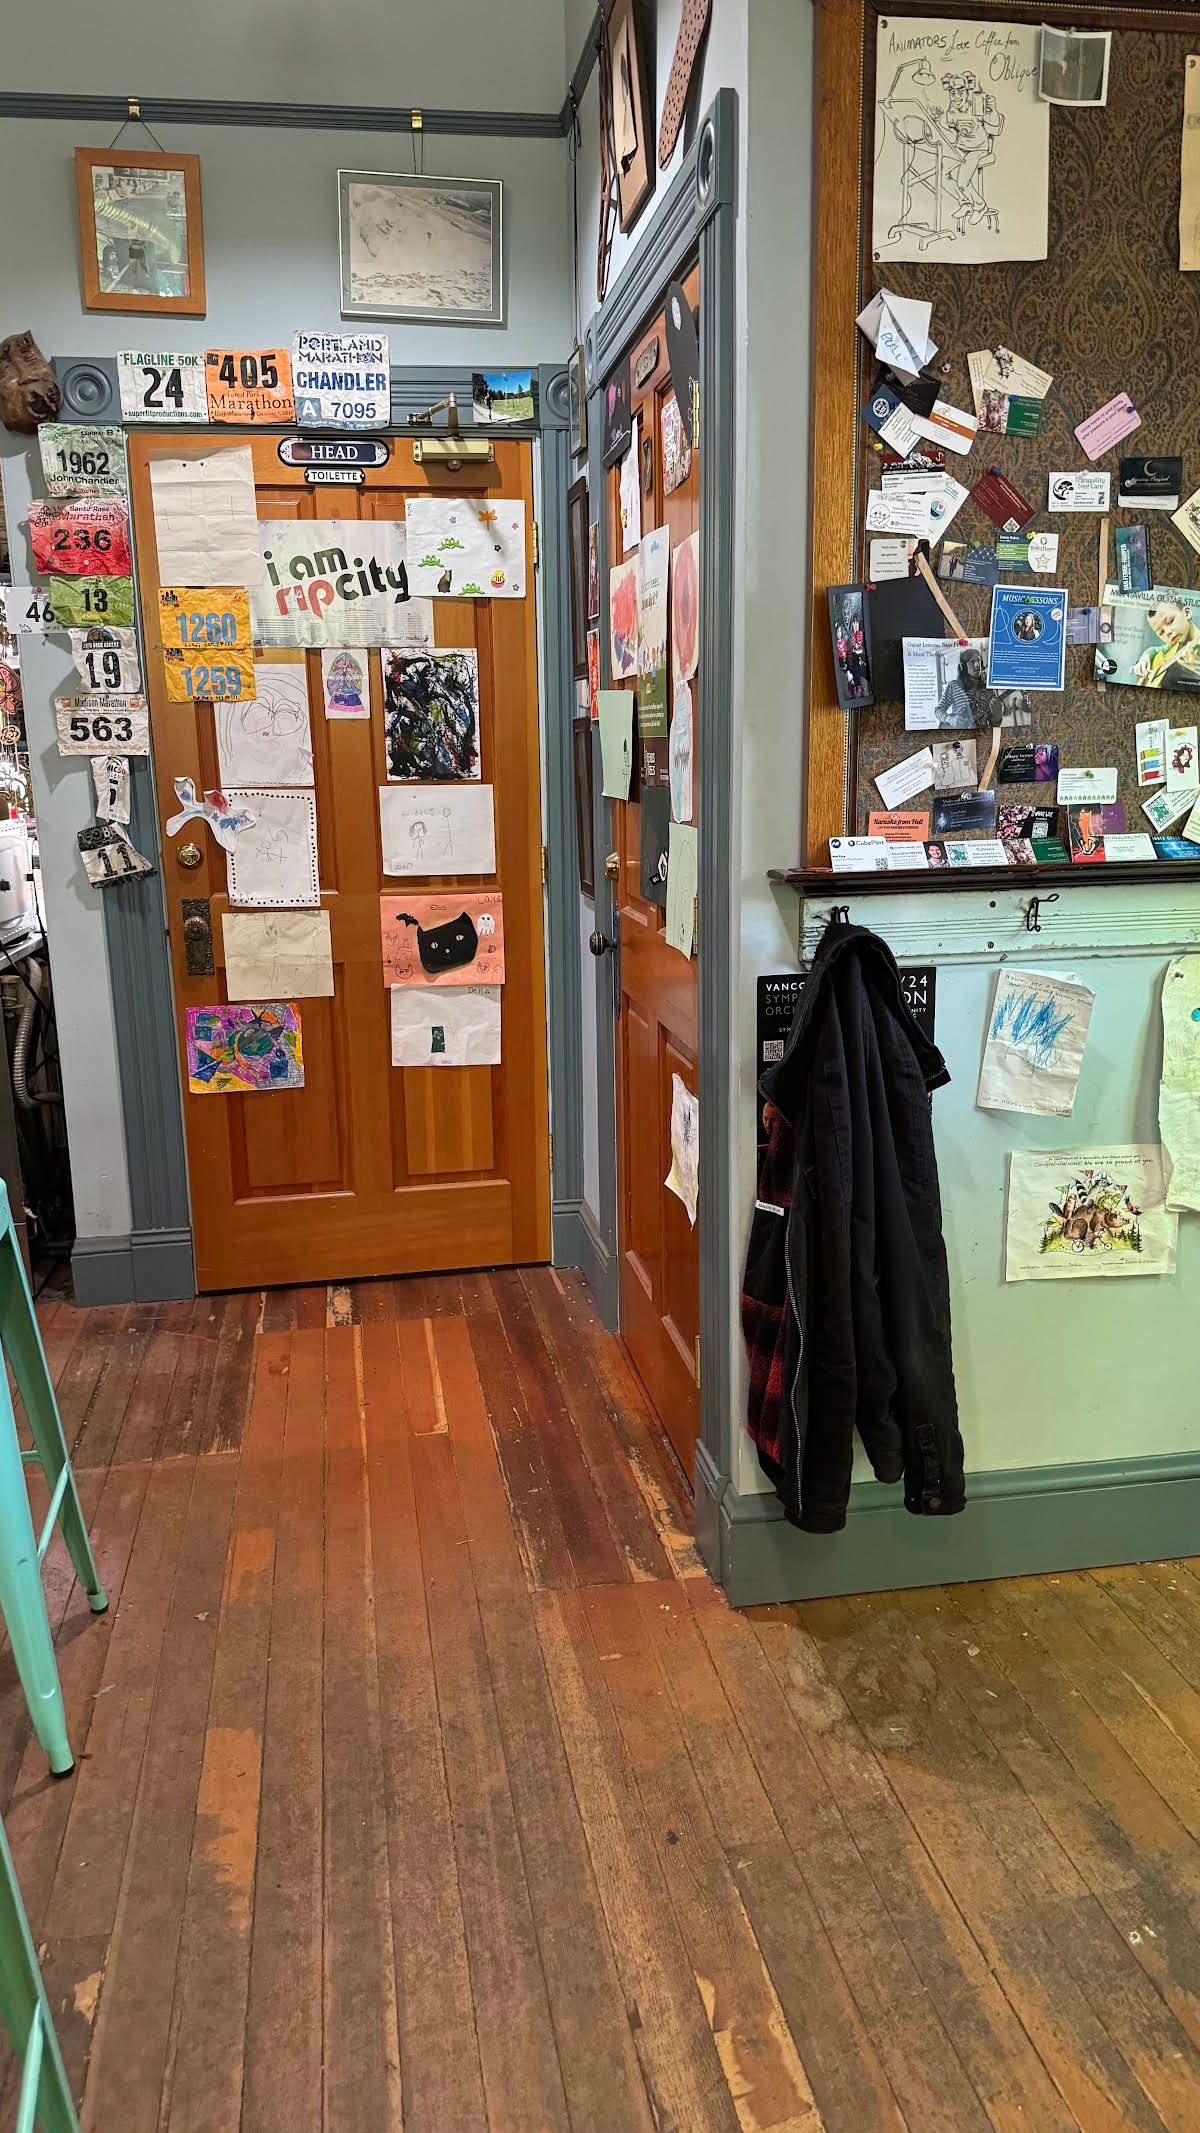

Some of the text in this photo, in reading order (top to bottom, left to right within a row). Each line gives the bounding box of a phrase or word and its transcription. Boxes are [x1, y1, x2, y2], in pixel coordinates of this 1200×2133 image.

[889, 32, 946, 53] ANIMATORS
[945, 29, 970, 55] Love
[975, 30, 1002, 55] Coffee
[989, 52, 1040, 92] Oblique
[299, 335, 382, 351] PORTLAND
[124, 354, 198, 366] FLAGLINE 50K
[299, 351, 383, 364] MARATHON
[219, 354, 278, 389] 405
[142, 367, 184, 408] 24
[297, 372, 386, 391] CHANDLER
[209, 393, 293, 409] Marathon
[247, 390, 260, 398] Park
[302, 400, 317, 417] A
[331, 402, 376, 419] 7095
[311, 445, 358, 460] HEAD
[57, 450, 110, 475] 1962
[51, 474, 119, 485] John Chandler
[311, 471, 358, 481] TOILETTE
[1075, 476, 1105, 484] Tranquility
[57, 512, 115, 521] Marathon
[54, 528, 112, 551] 236
[264, 548, 348, 587] i am
[81, 588, 108, 612] 13
[1002, 594, 1025, 603] MUSIC
[1157, 594, 1183, 606] GUITAR
[176, 612, 237, 642] 1260
[86, 651, 122, 689] 19
[181, 666, 242, 697] 1259
[75, 698, 126, 708] Madison Marathon
[70, 717, 133, 742] 563
[97, 843, 137, 878] 11
